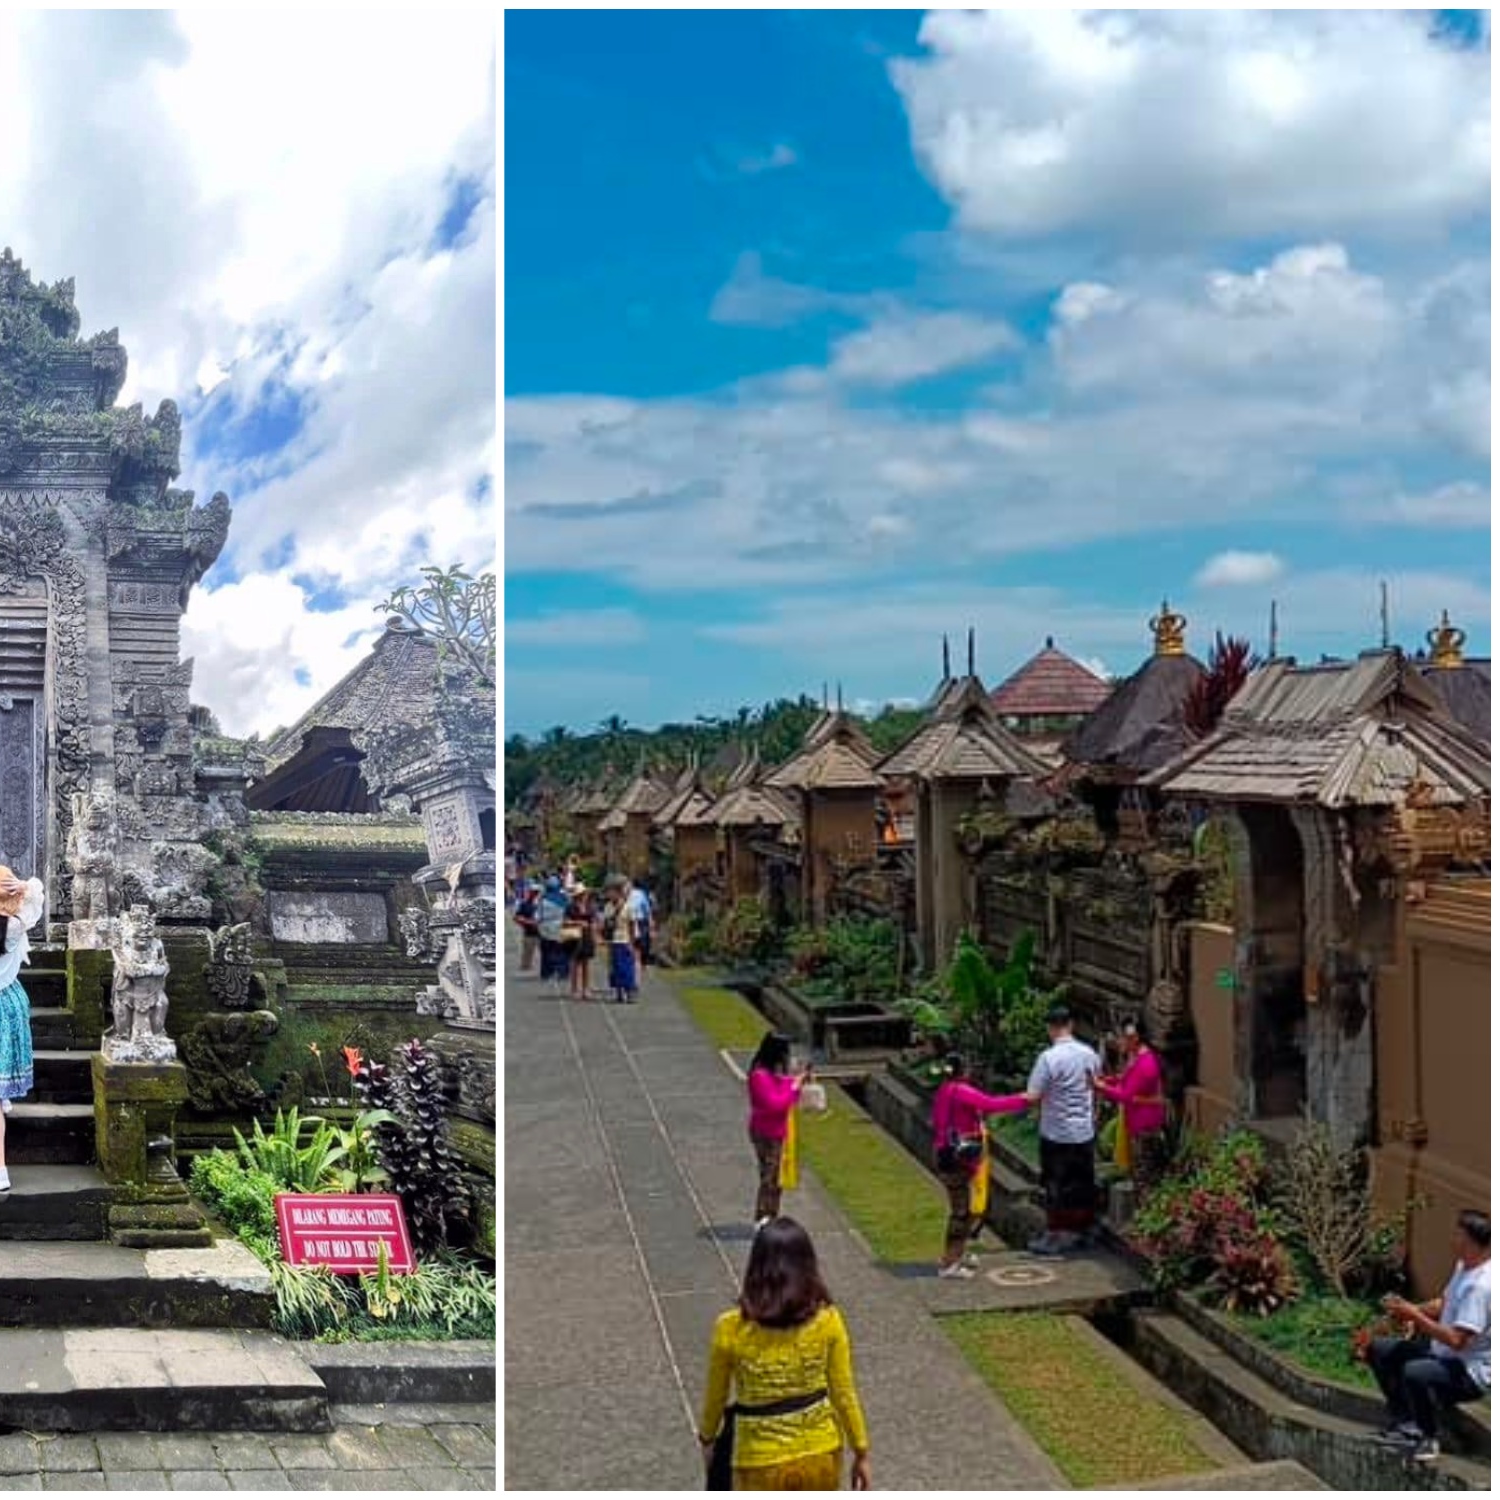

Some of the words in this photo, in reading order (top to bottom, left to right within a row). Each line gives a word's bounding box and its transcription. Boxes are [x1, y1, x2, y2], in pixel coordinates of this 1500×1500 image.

[303, 1240, 316, 1257] DO
[315, 1240, 331, 1257] NOT
[331, 1240, 352, 1257] HOLD
[352, 1240, 368, 1258] THE
